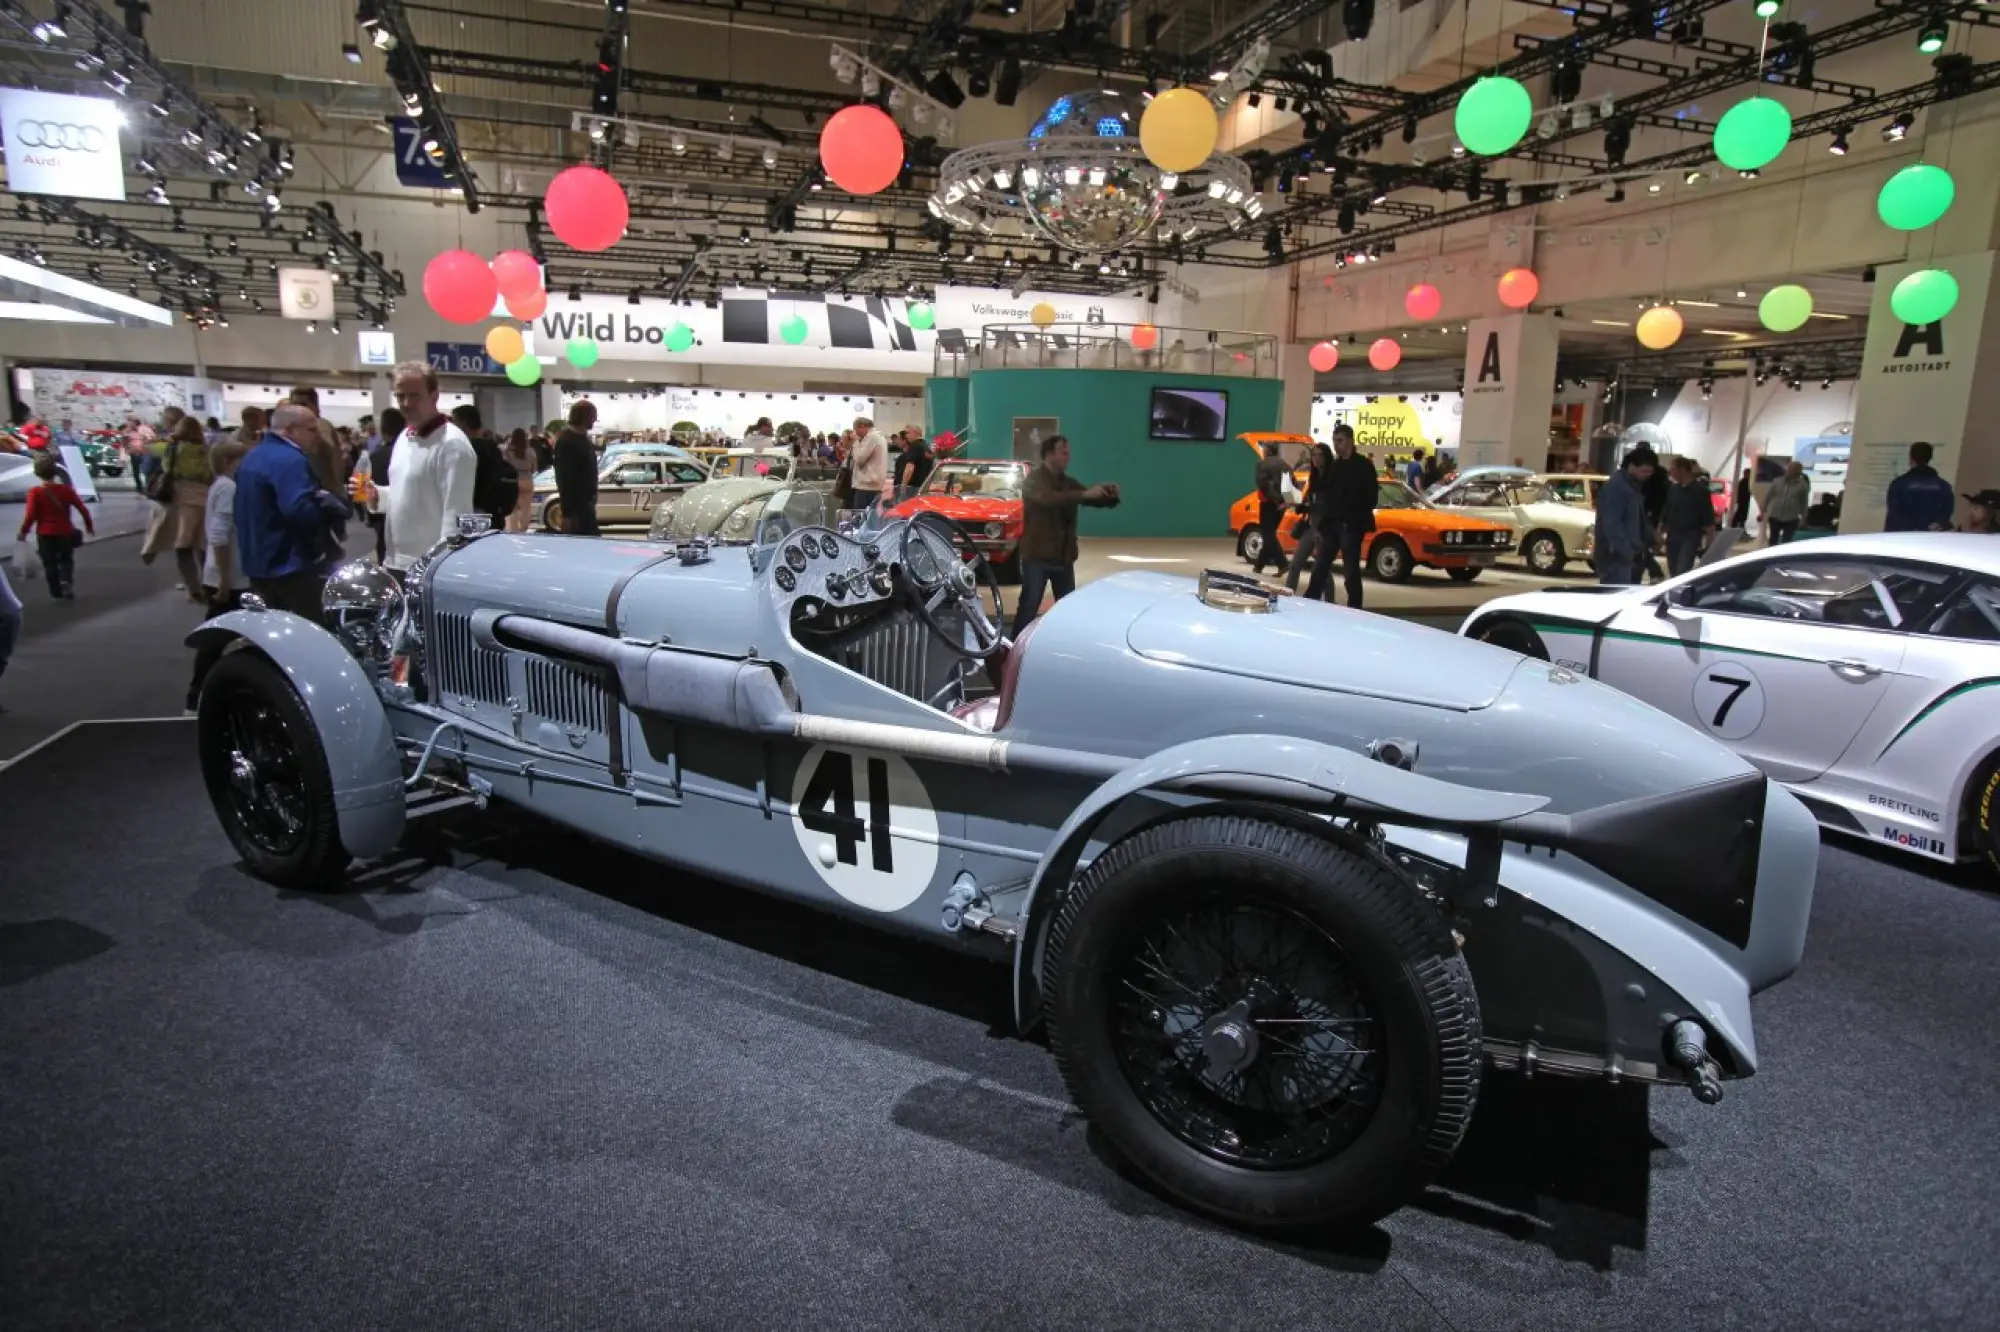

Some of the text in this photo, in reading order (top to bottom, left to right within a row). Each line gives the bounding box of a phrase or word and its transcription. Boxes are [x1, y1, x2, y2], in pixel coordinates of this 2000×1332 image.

[23, 153, 62, 167] Audi
[972, 303, 1033, 319] Volkswage
[542, 311, 615, 343] Wild
[1477, 331, 1501, 383] A
[1882, 361, 1951, 373] AUTOSTADT
[1358, 411, 1405, 430] Happy
[632, 490, 651, 512] 72
[1709, 674, 1751, 727] 7
[799, 749, 893, 874] 41
[1868, 794, 1940, 823] BREITLING
[1884, 826, 1928, 851] Mobil
